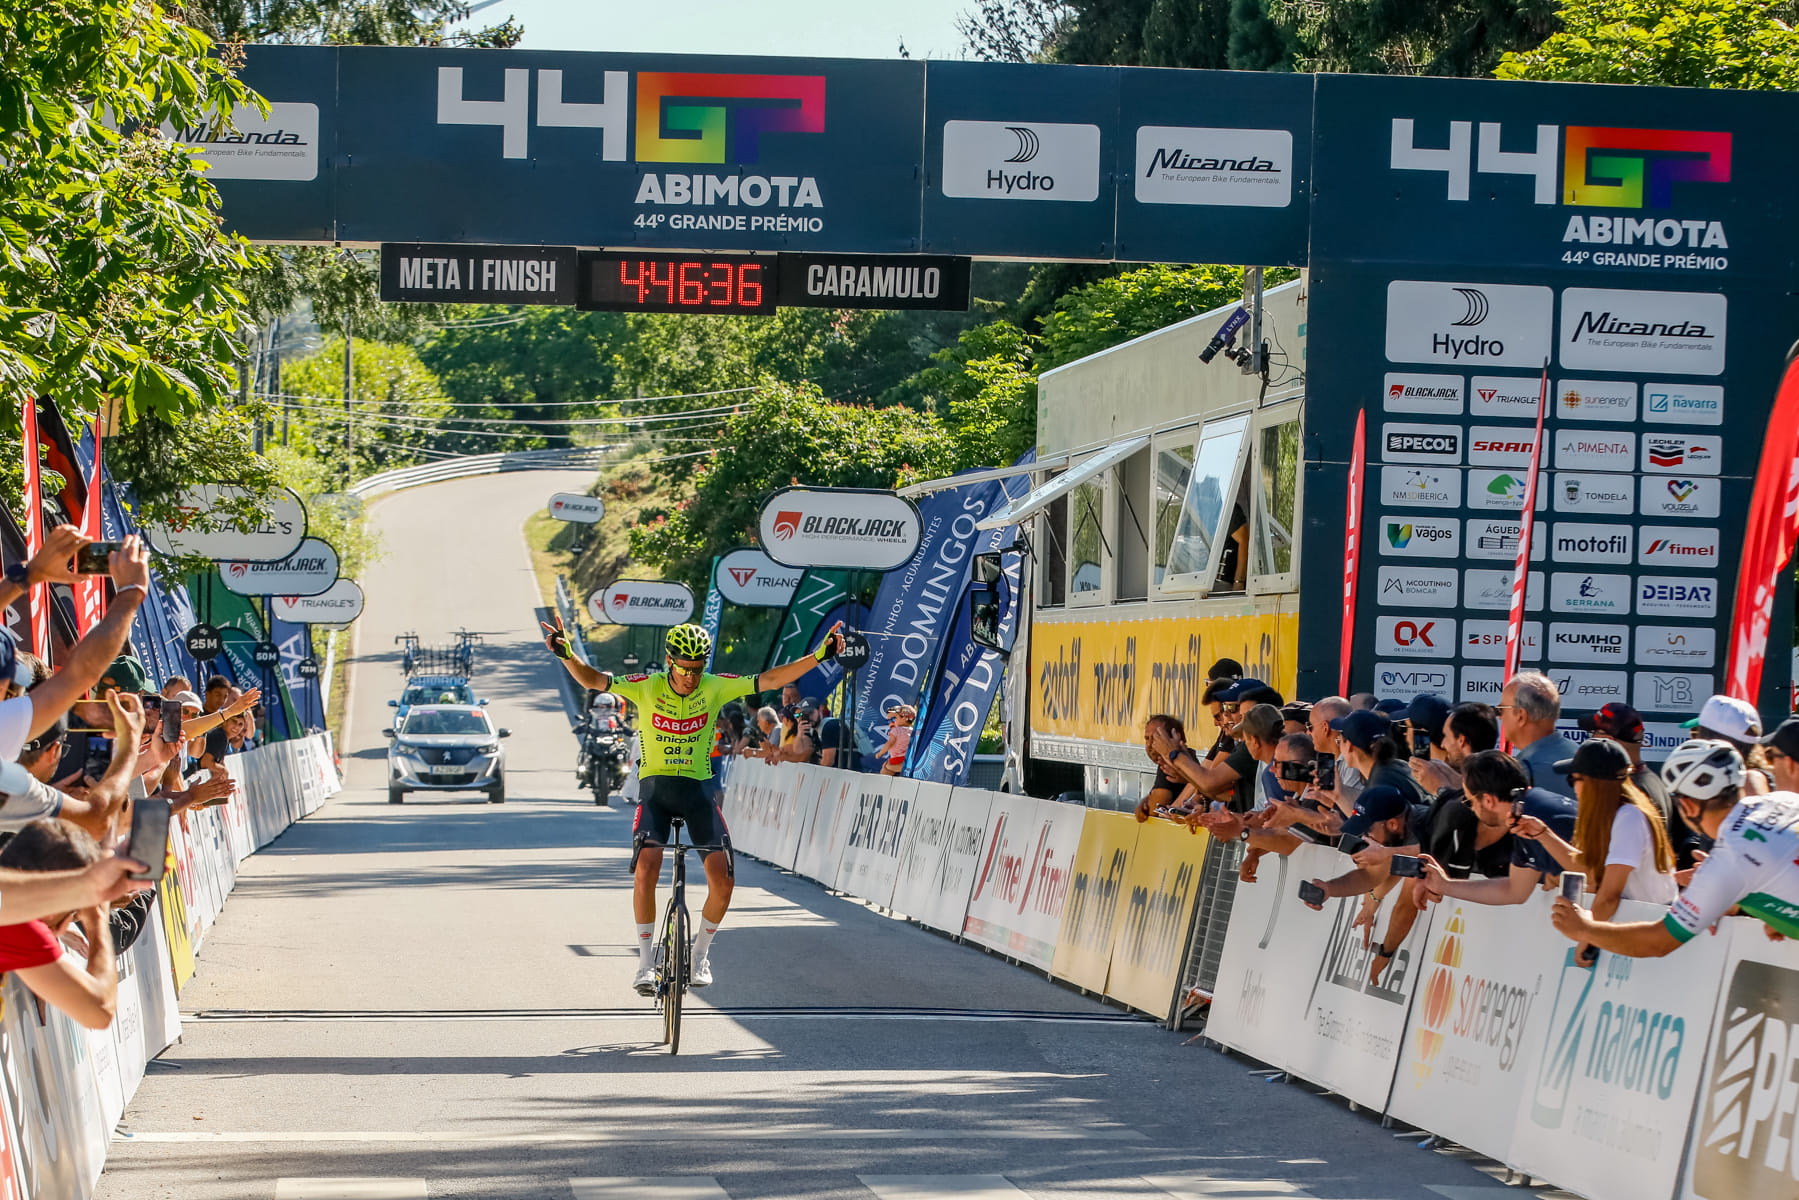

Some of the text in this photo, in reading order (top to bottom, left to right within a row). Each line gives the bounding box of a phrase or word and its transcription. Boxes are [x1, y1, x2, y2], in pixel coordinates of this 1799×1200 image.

[437, 66, 628, 162] 44
[237, 149, 251, 157] Bike
[1391, 118, 1559, 205] 44
[1146, 147, 1281, 178] Miranda
[987, 169, 1054, 193] Hydro
[1161, 173, 1175, 181] The
[1177, 174, 1211, 183] European
[634, 173, 824, 208] ABIMOTA
[633, 213, 823, 232] 44º GRANDE PRÉMIO
[1562, 215, 1729, 249] ABIMOTA
[1561, 250, 1728, 270] 44º GRANDE PRÉMIO
[399, 257, 556, 292] META FINISH
[806, 264, 940, 299] CARAMULO
[620, 260, 763, 307] 4:46:36
[1225, 315, 1242, 333] LYNX
[1572, 311, 1715, 343] Miranda
[1432, 333, 1504, 359] Hydro
[1587, 338, 1601, 346] The
[1603, 339, 1639, 349] European
[1641, 340, 1657, 348] Bike
[1405, 386, 1458, 398] BLACKJACK
[1673, 399, 1717, 409] navarra
[1402, 437, 1455, 451] PECOL
[1577, 442, 1629, 454] PIMENTA
[1584, 492, 1628, 501] TONDELA
[802, 514, 906, 538] BLACKJACK
[1486, 523, 1522, 534] ÁGUED
[820, 534, 875, 542] PERFORMANCE
[1415, 528, 1453, 542] vagos
[1558, 535, 1627, 554] motofil
[1669, 543, 1714, 556] fimel
[890, 496, 985, 688] DOMINGOS
[1405, 580, 1452, 588] MCOUTINHO
[1642, 584, 1711, 601] DEIBAR
[629, 596, 687, 609] BLACKJACK
[1565, 598, 1615, 607] SERRANA
[855, 514, 943, 722] ESPUMANTES VINHOS AGUARDENTES
[1394, 621, 1435, 647] OK
[1556, 633, 1622, 645] KUMHO
[190, 638, 217, 649] 25M
[1591, 645, 1622, 654] TIRE
[654, 716, 705, 732] SABGAL
[656, 734, 701, 744] anicolor
[944, 701, 979, 775] SÃO
[664, 746, 682, 755] Q8
[1584, 1000, 1685, 1101] navarra
